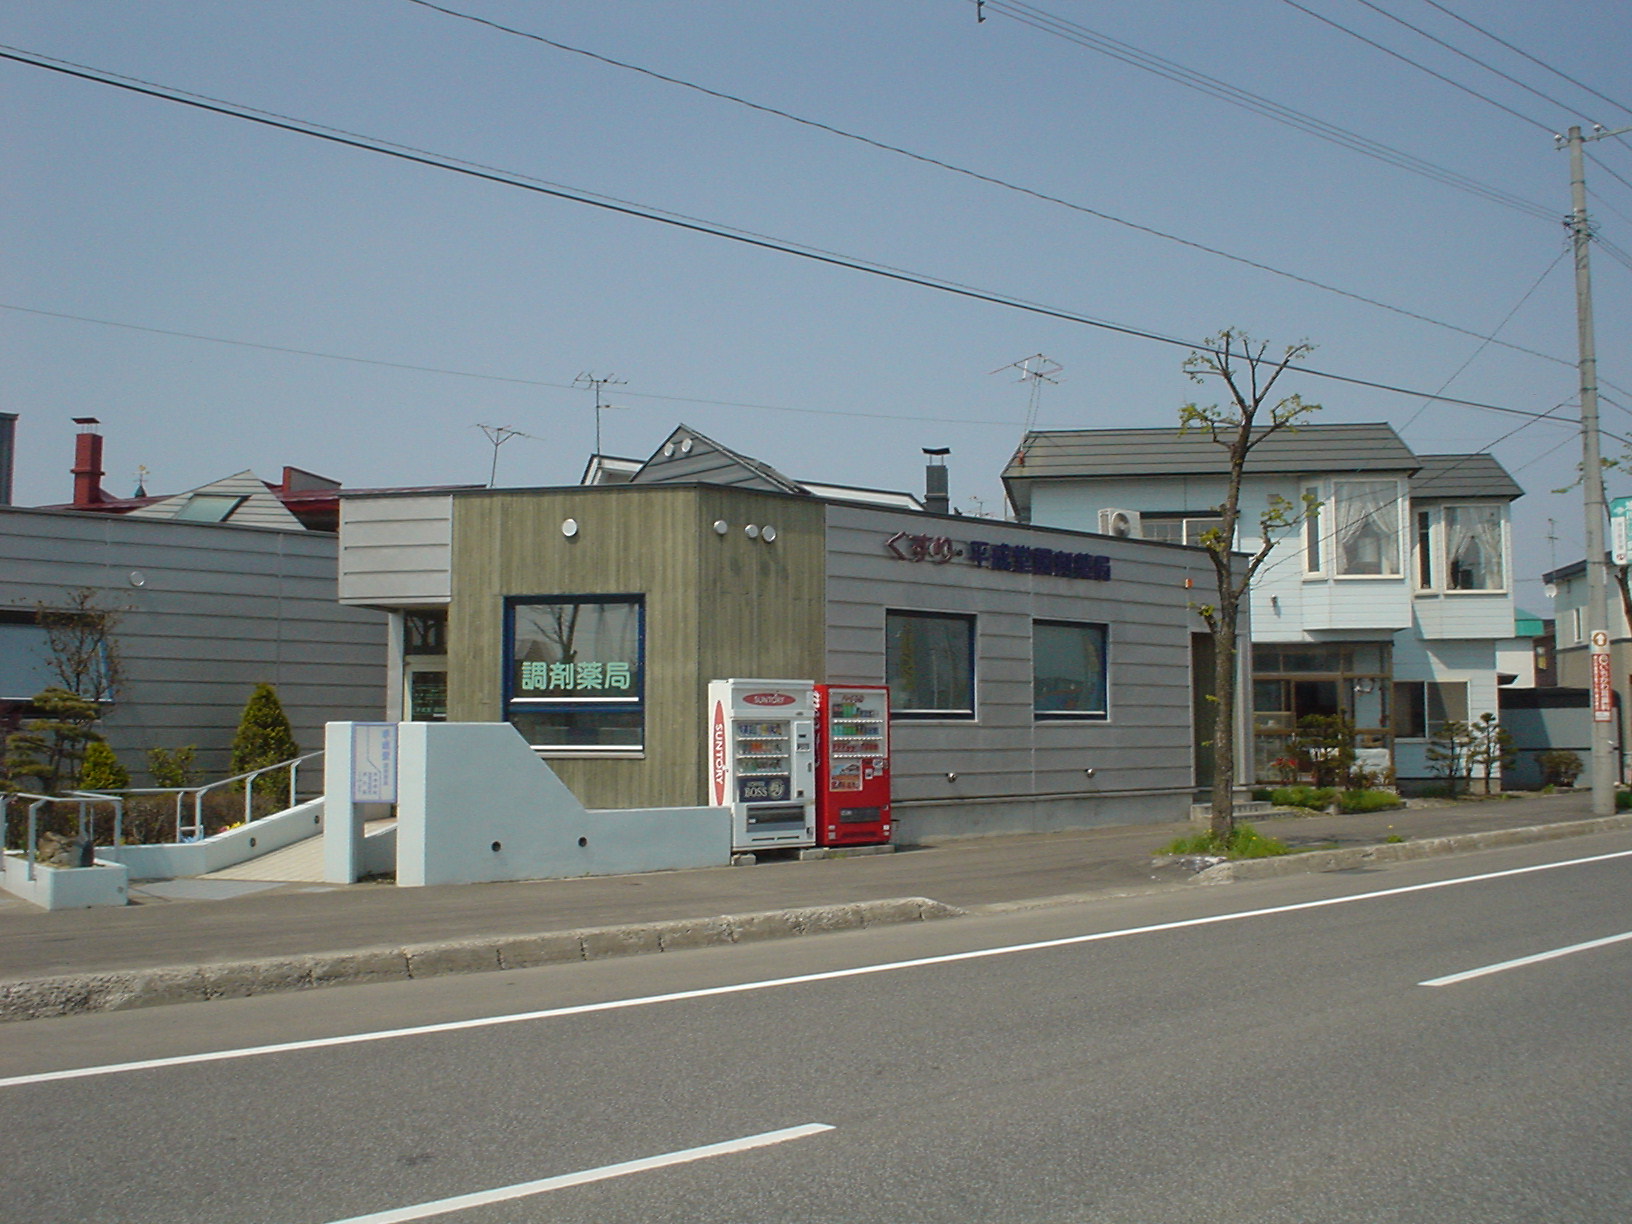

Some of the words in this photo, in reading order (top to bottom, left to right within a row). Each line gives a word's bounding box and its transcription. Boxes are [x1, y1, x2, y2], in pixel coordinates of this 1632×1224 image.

[522, 661, 630, 690] 調剤薬局
[715, 723, 724, 785] SUNTORY
[745, 787, 767, 798] BOSS
